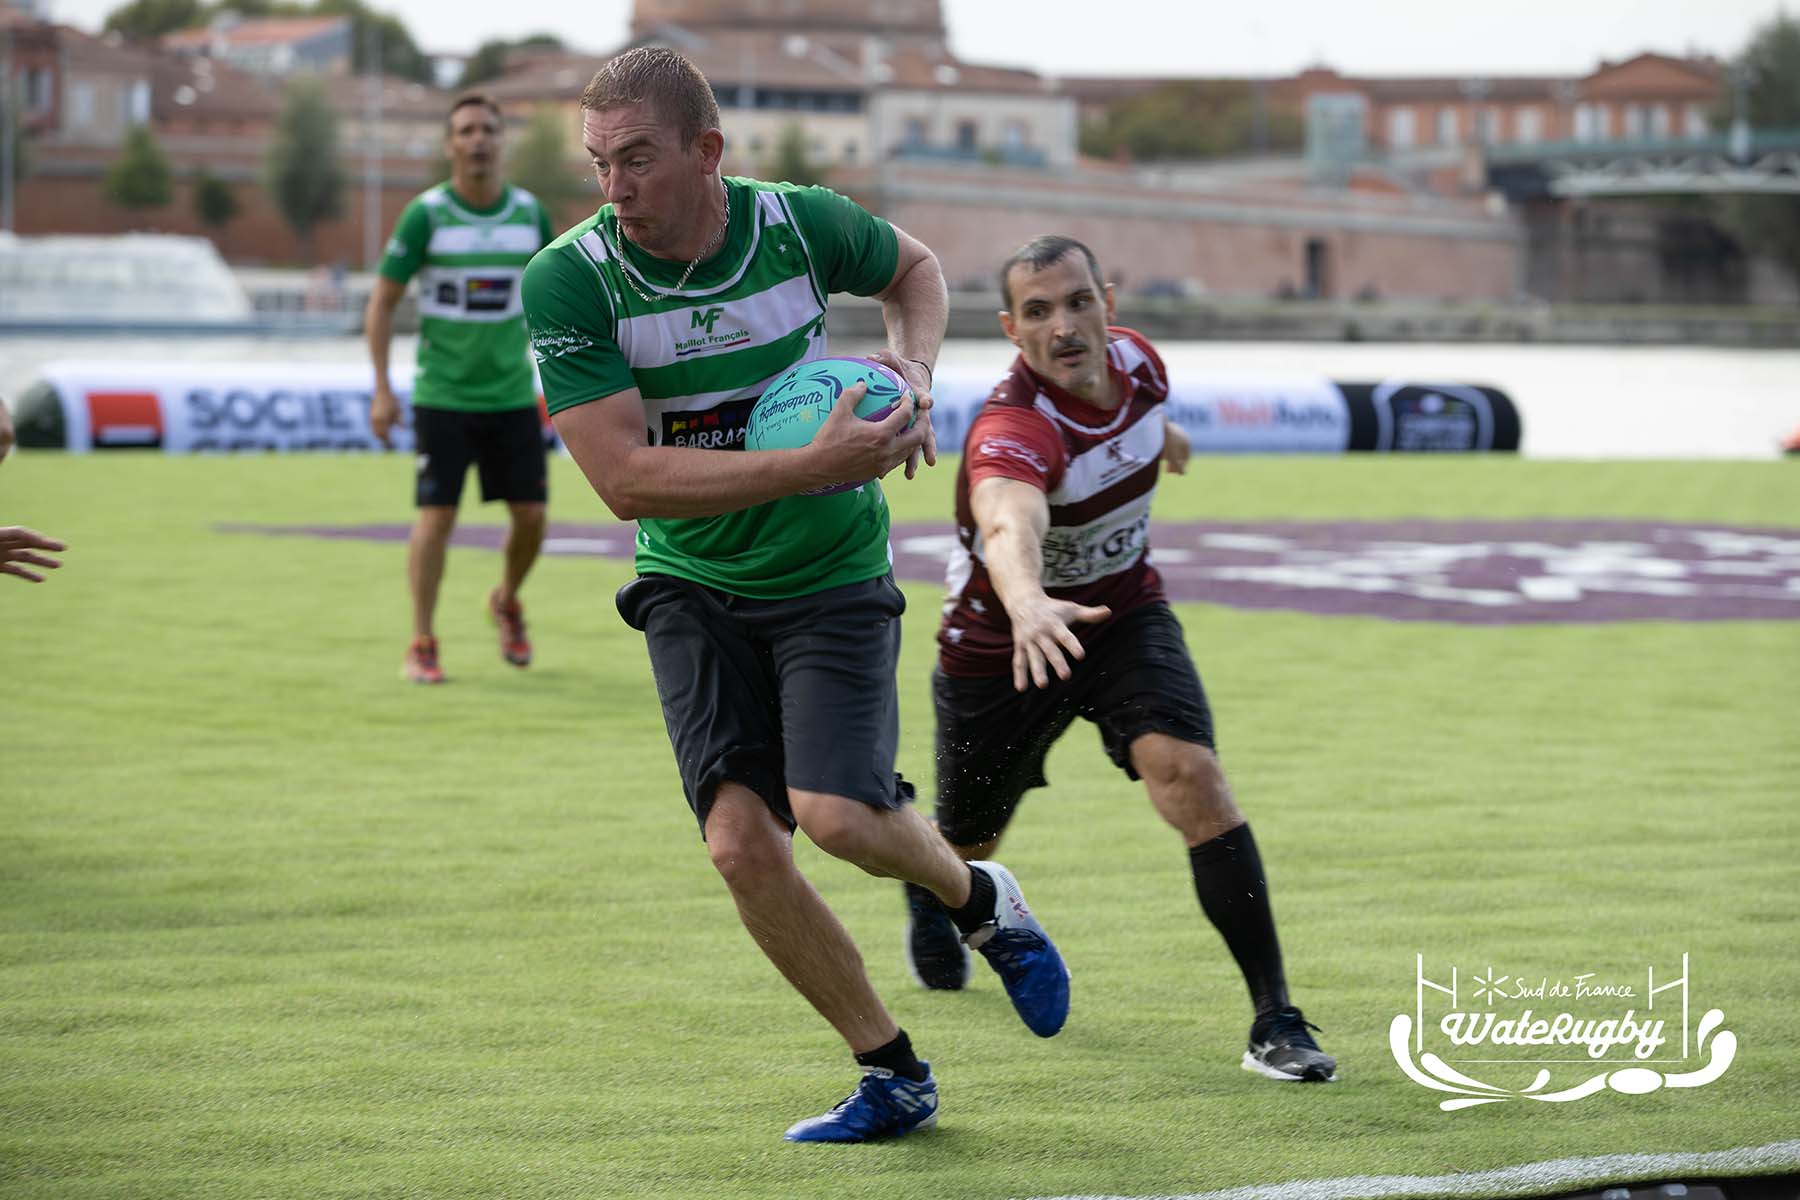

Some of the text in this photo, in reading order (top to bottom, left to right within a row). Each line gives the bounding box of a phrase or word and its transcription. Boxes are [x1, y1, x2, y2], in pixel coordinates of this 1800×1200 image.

[691, 307, 725, 333] MF
[675, 328, 750, 351] Maillot Français
[186, 388, 413, 431] SOCIET
[760, 391, 823, 421] WateRugby
